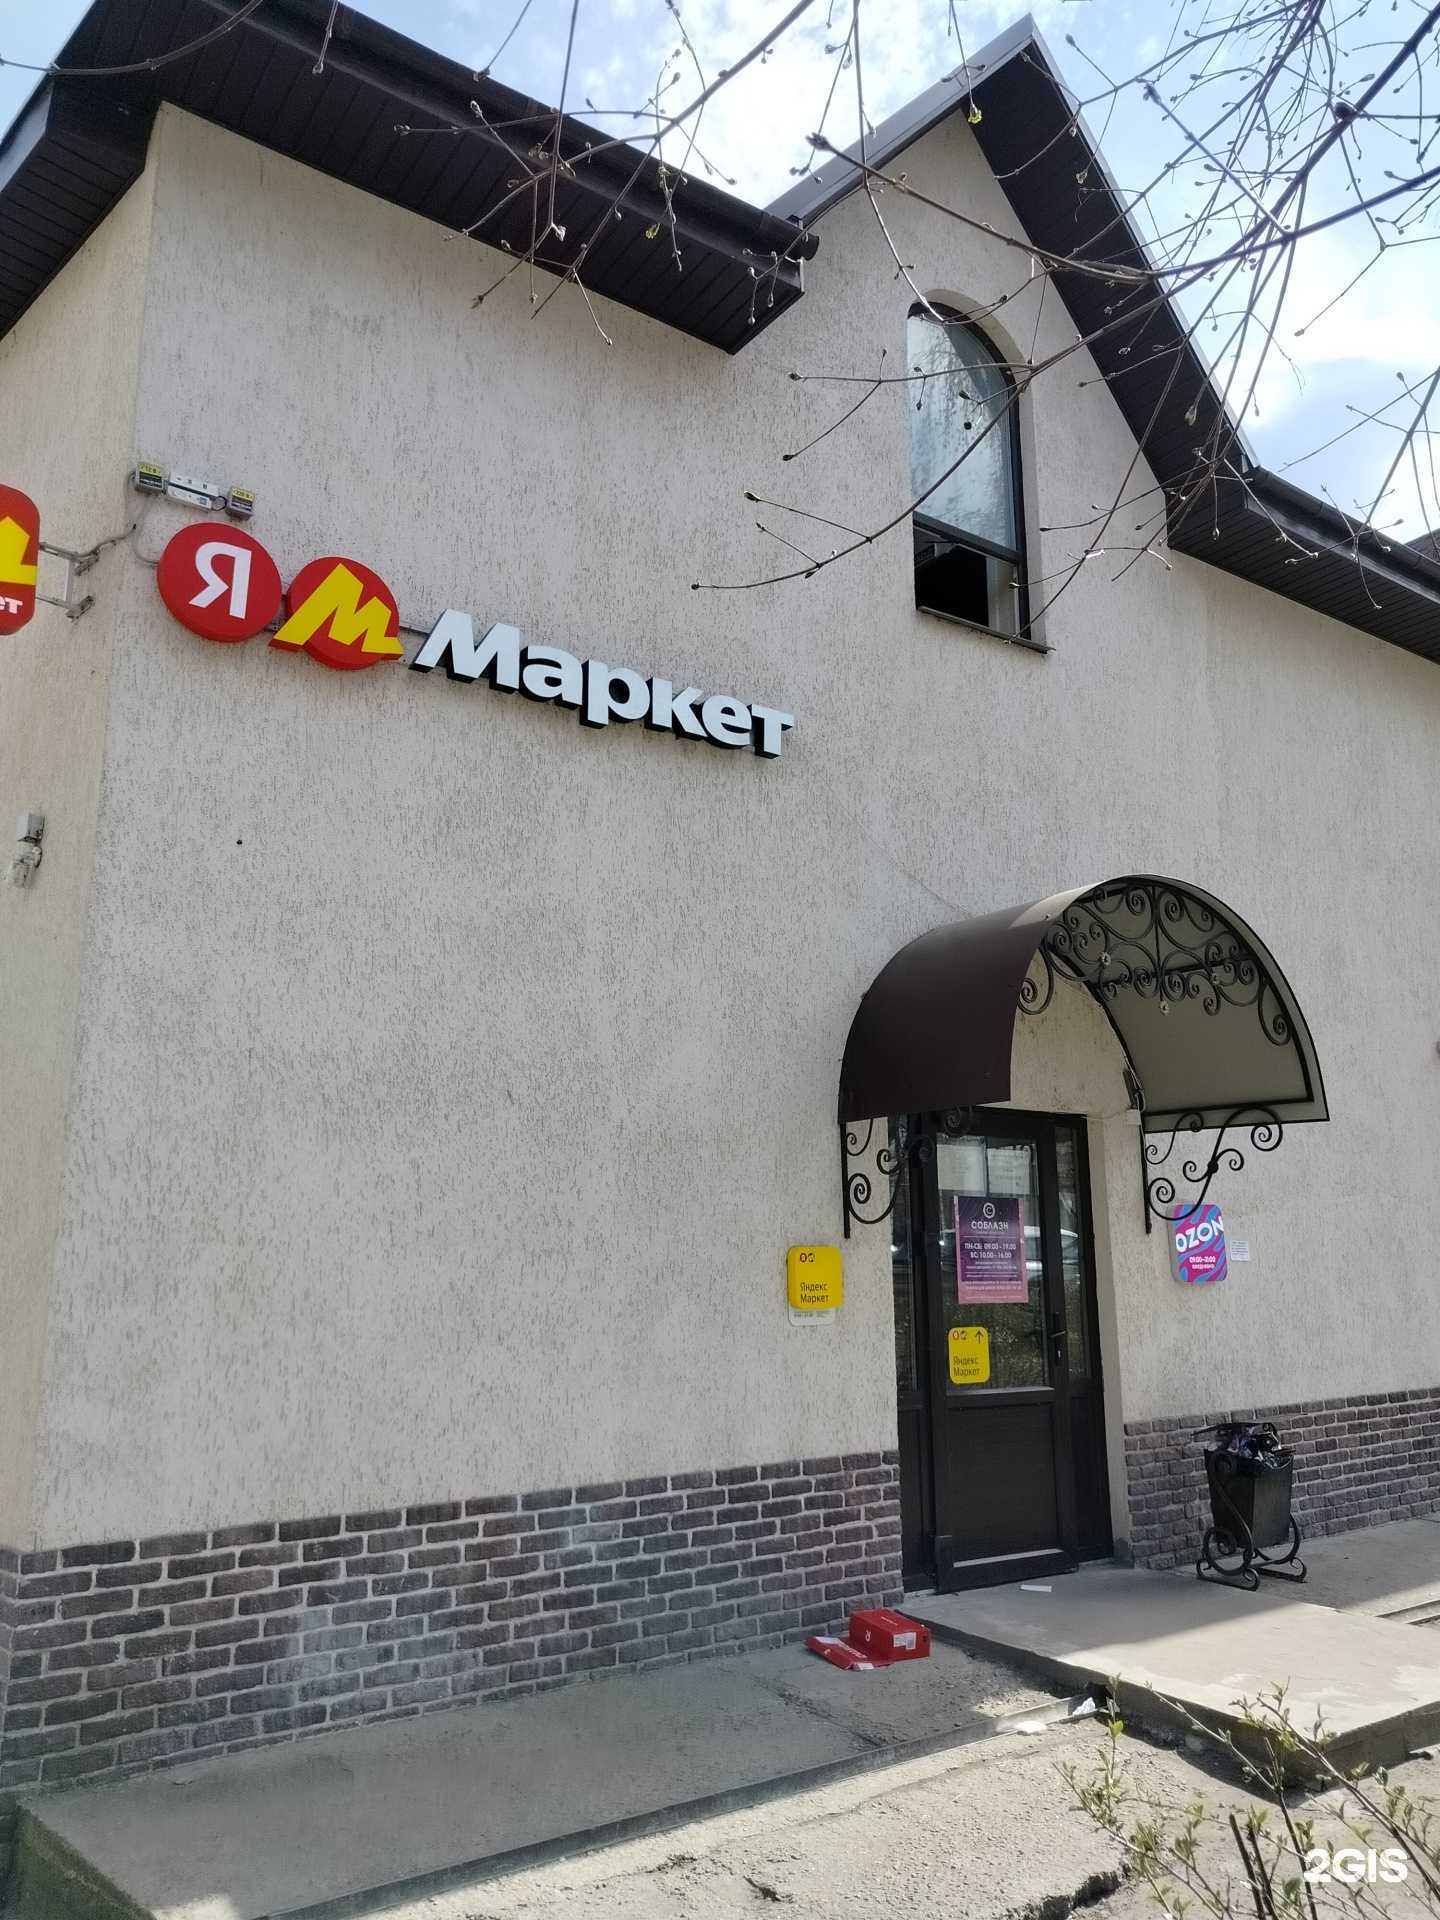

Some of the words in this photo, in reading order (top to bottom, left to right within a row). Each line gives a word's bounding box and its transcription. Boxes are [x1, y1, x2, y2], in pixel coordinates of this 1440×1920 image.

[188, 541, 252, 620] Я
[409, 608, 794, 759] Маркет
[971, 1220, 1009, 1231] СОБЛАЗН
[1175, 1215, 1225, 1253] OZON
[800, 1282, 828, 1292] Яндекс
[800, 1293, 829, 1304] Маркет
[953, 1366, 980, 1377] Маркет
